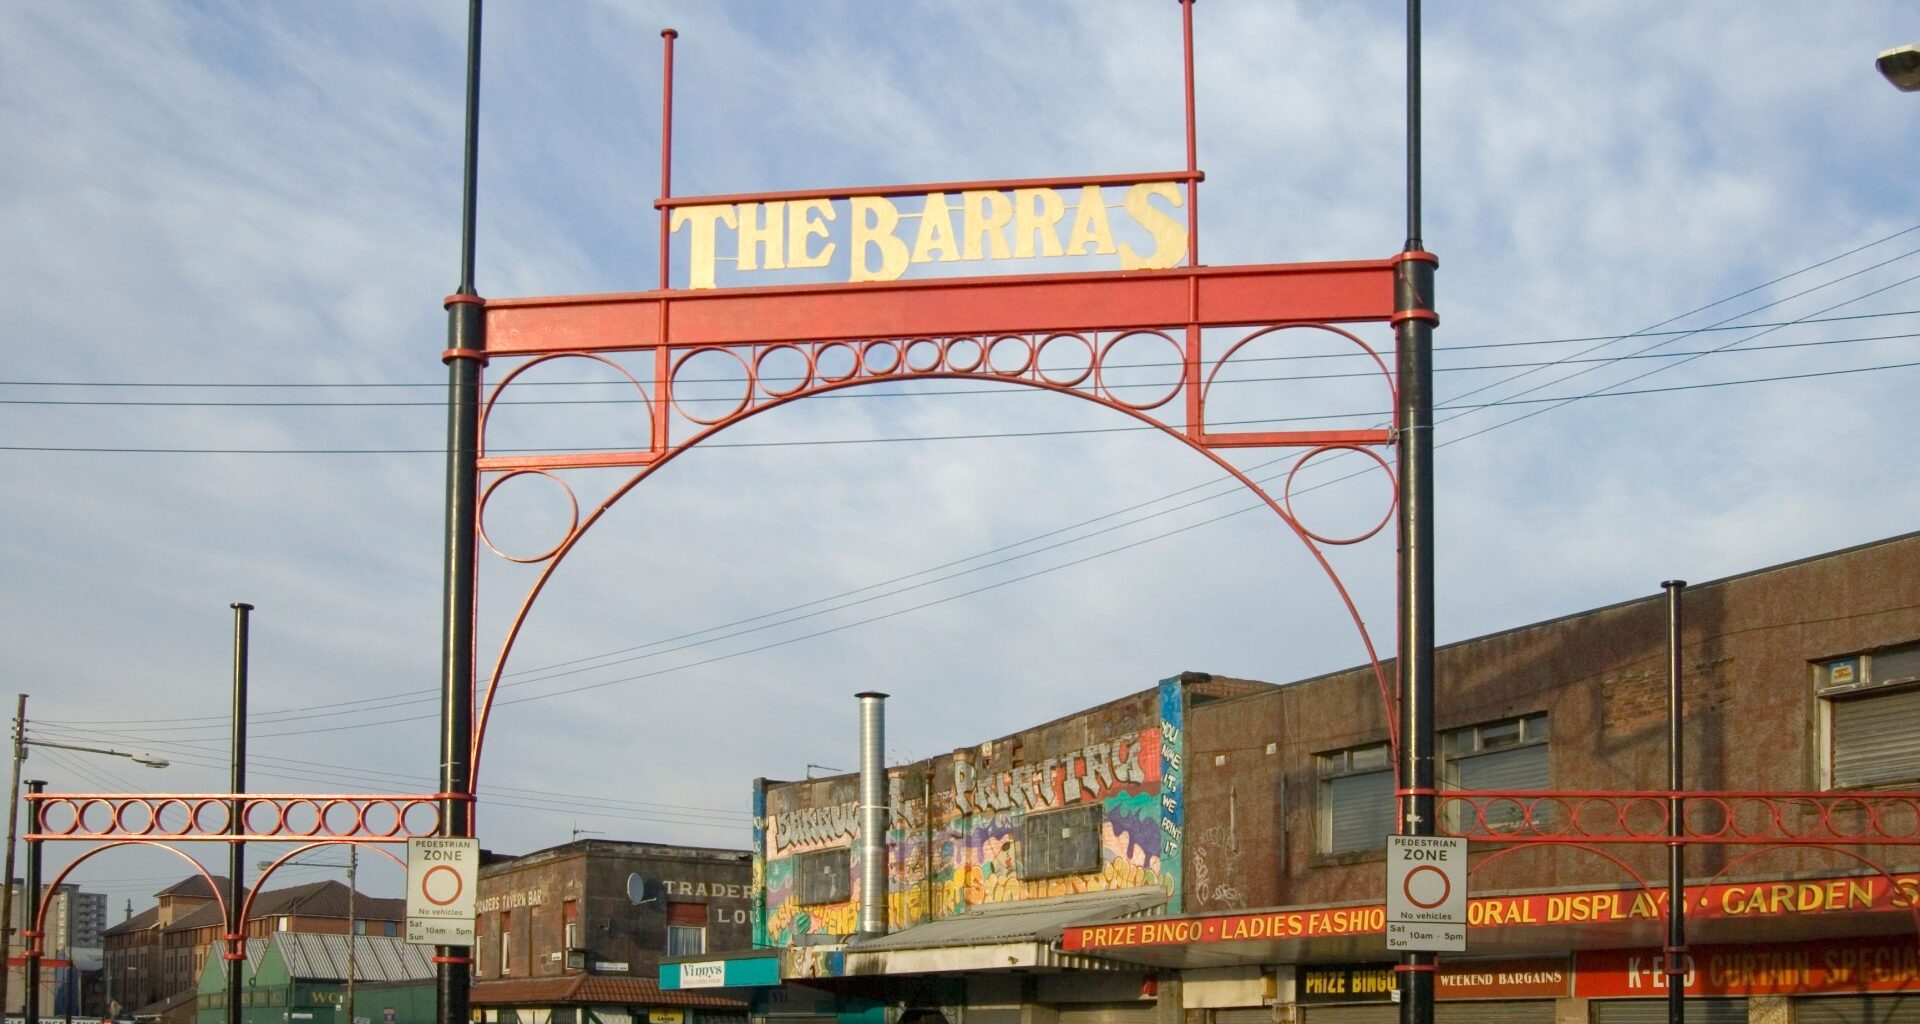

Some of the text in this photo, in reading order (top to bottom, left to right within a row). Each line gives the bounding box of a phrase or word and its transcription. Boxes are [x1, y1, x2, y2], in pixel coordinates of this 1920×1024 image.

[669, 181, 1189, 290] THE BARRAS
[1161, 721, 1179, 744] YOU
[1162, 795, 1177, 814] WE
[415, 840, 471, 848] PEDESTRIAN
[1395, 839, 1457, 848] PEDESTRIAN
[423, 850, 462, 861] ZONE
[1403, 849, 1448, 861] ZONE
[502, 893, 526, 909] TAVERN
[528, 889, 542, 905] BAR
[432, 908, 463, 916] vehicles
[1081, 925, 1137, 948] PRIZE
[1141, 921, 1203, 944] BINGO
[1221, 914, 1303, 940] LADIES
[1722, 880, 1873, 916] GARDEN
[1416, 912, 1452, 920] vehicles
[1390, 938, 1407, 946] Sun
[1410, 932, 1433, 940] 10am
[1445, 933, 1463, 941] 5pm
[1628, 956, 1695, 989] K-ED
[1710, 951, 1810, 987] CURTAIN
[1306, 969, 1397, 994] PRIZE BINGO
[1440, 970, 1562, 986] WEEKEND BARGAINS
